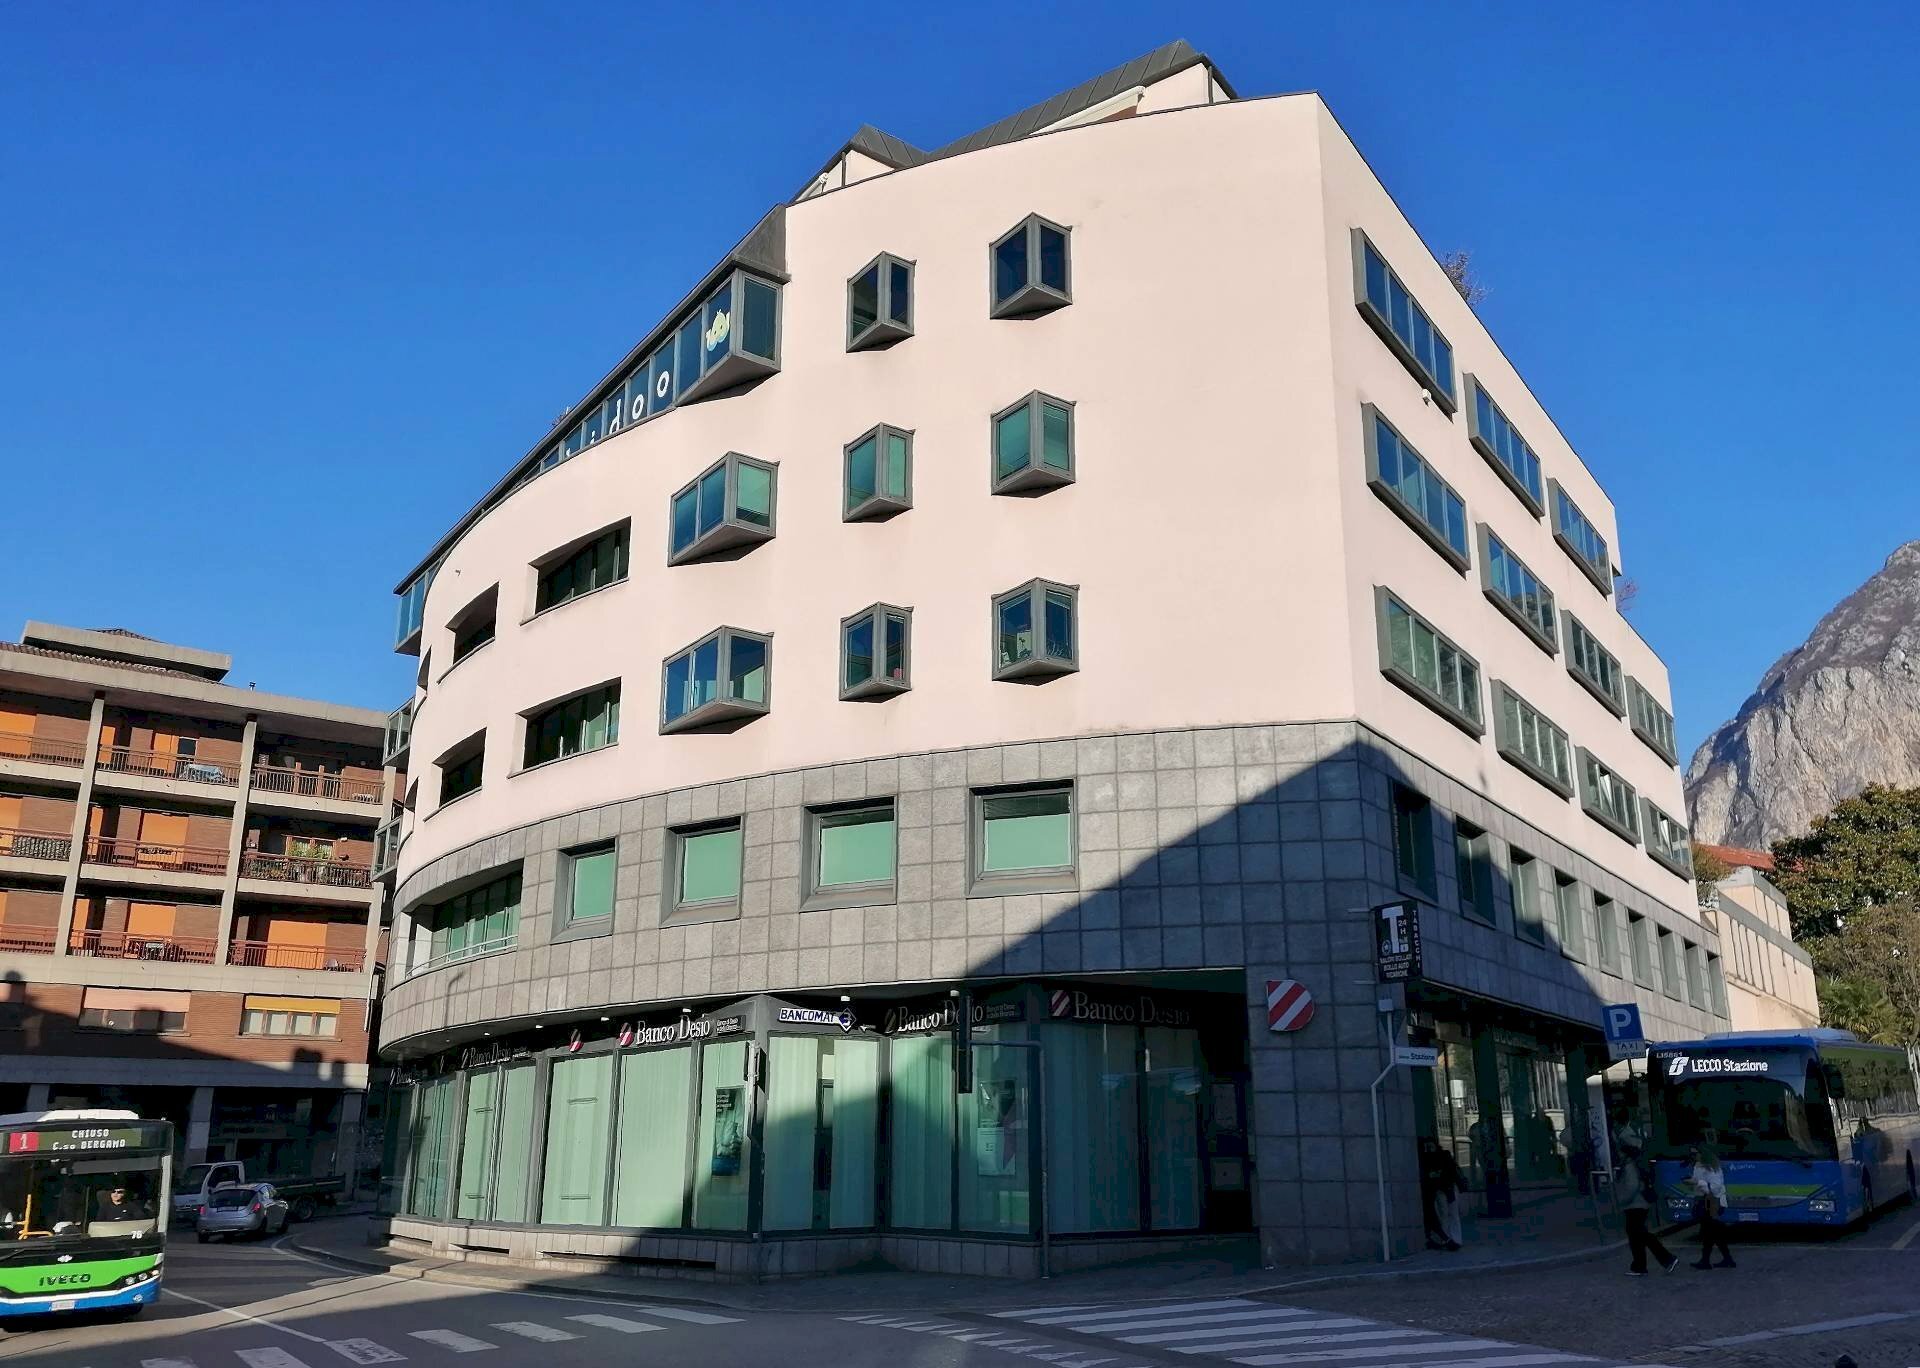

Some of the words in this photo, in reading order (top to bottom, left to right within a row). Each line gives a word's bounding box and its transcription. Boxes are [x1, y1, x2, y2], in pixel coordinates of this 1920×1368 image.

[1071, 990, 1135, 1021] Banco
[1139, 995, 1191, 1025] Desio
[780, 1009, 836, 1023] BANCOMAT
[897, 1005, 941, 1031] Banco
[1609, 1008, 1632, 1038] P
[636, 1020, 675, 1046] Banco
[679, 1014, 711, 1041] Desio
[1616, 1041, 1638, 1051] TAXI
[1691, 1058, 1722, 1073] LECCO
[1723, 1059, 1769, 1072] Stazione
[19, 1133, 28, 1150] 1
[80, 1139, 126, 1150] BERGAMO
[39, 1273, 91, 1287] IVECO
